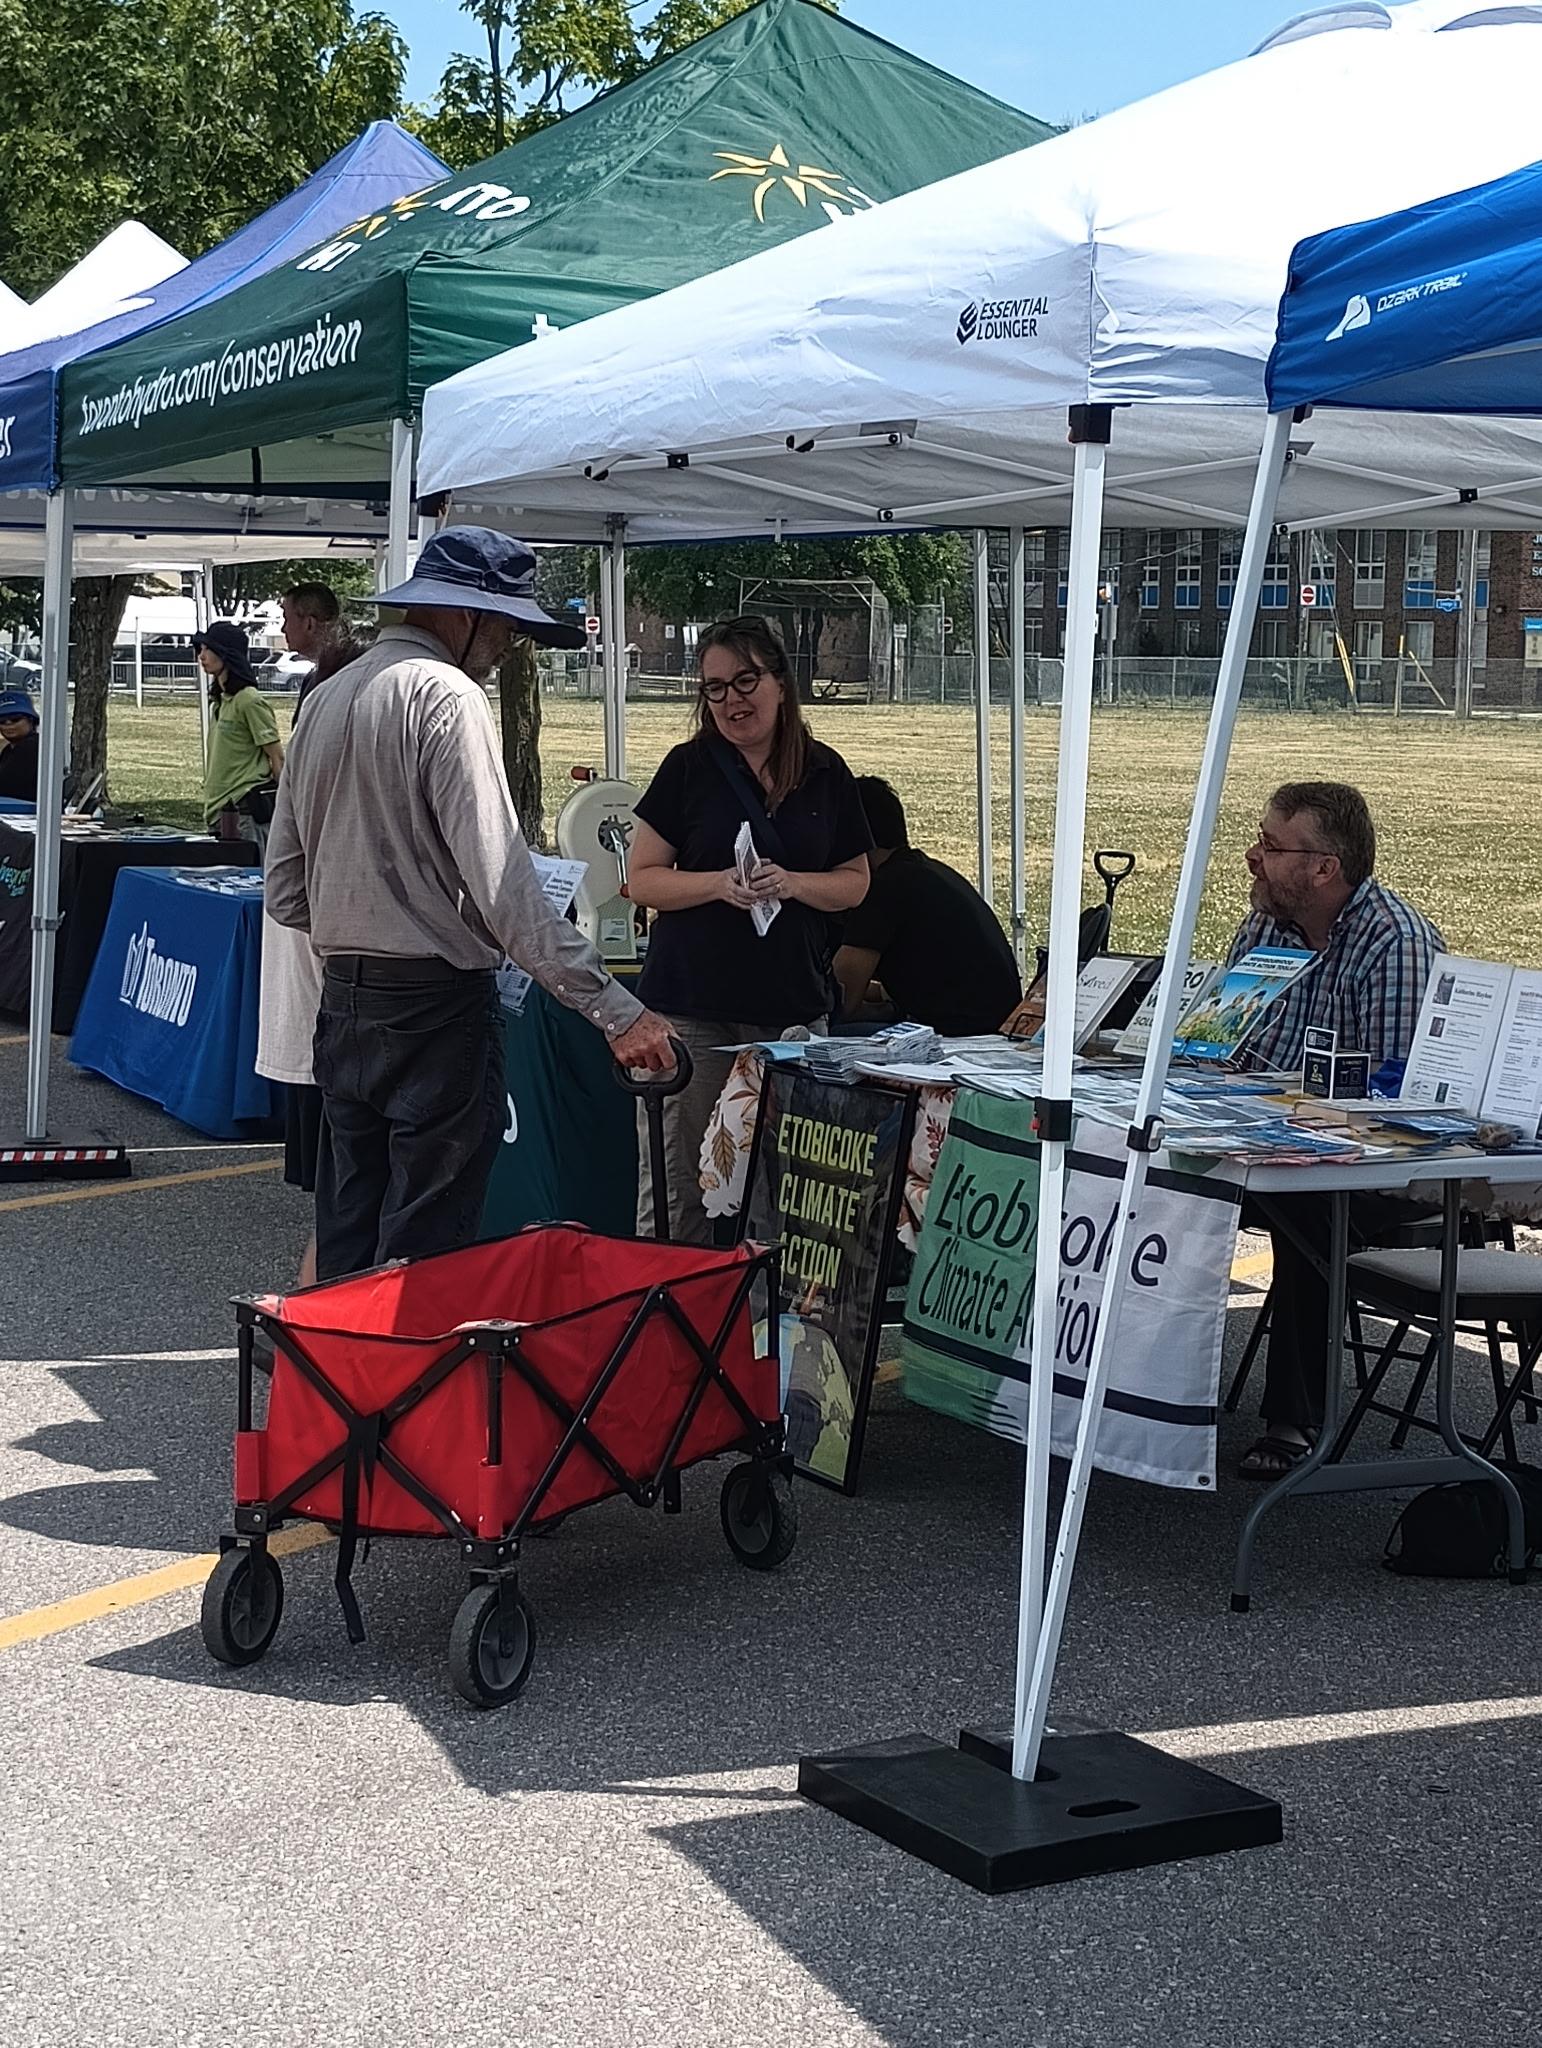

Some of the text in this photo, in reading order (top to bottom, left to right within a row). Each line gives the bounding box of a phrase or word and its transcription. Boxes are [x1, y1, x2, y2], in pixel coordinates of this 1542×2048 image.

[979, 296, 1049, 320] ESSENTIAL
[1376, 273, 1463, 312] OZARK TRAIL
[976, 318, 1038, 340] LOUNGER
[79, 312, 363, 436] torontohydro.com/conservation
[135, 936, 198, 1027] TORONTO
[777, 1112, 879, 1177] ETOBICOKE
[778, 1172, 861, 1233] CLIMATE
